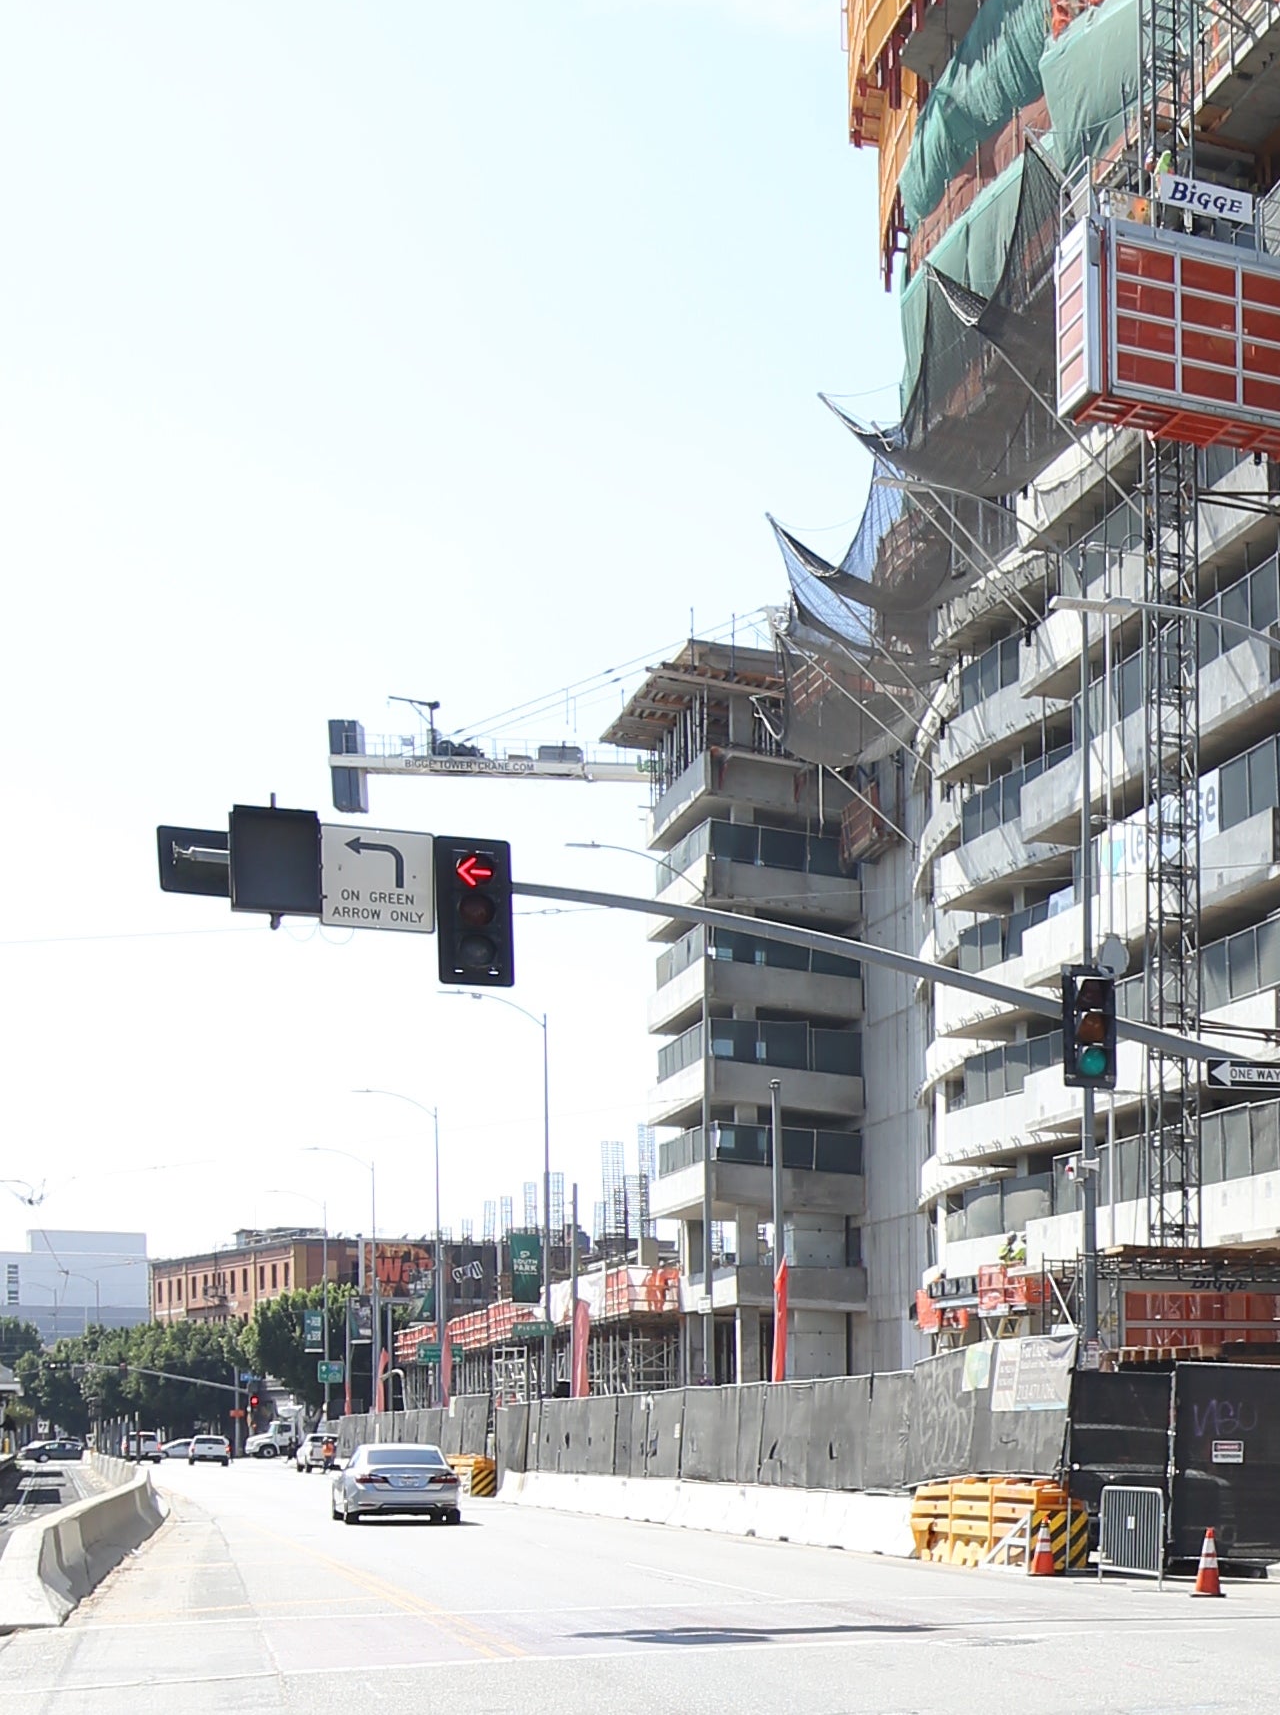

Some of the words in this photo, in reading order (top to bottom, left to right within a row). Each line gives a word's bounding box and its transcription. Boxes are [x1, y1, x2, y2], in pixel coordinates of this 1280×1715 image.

[404, 759, 435, 769] BIGGE
[438, 760, 474, 771] TOWER
[341, 889, 360, 901] ON
[369, 891, 415, 905] GREEN
[332, 906, 381, 920] ARROW
[390, 910, 425, 923] ONLY
[1230, 1068, 1253, 1080] ONE
